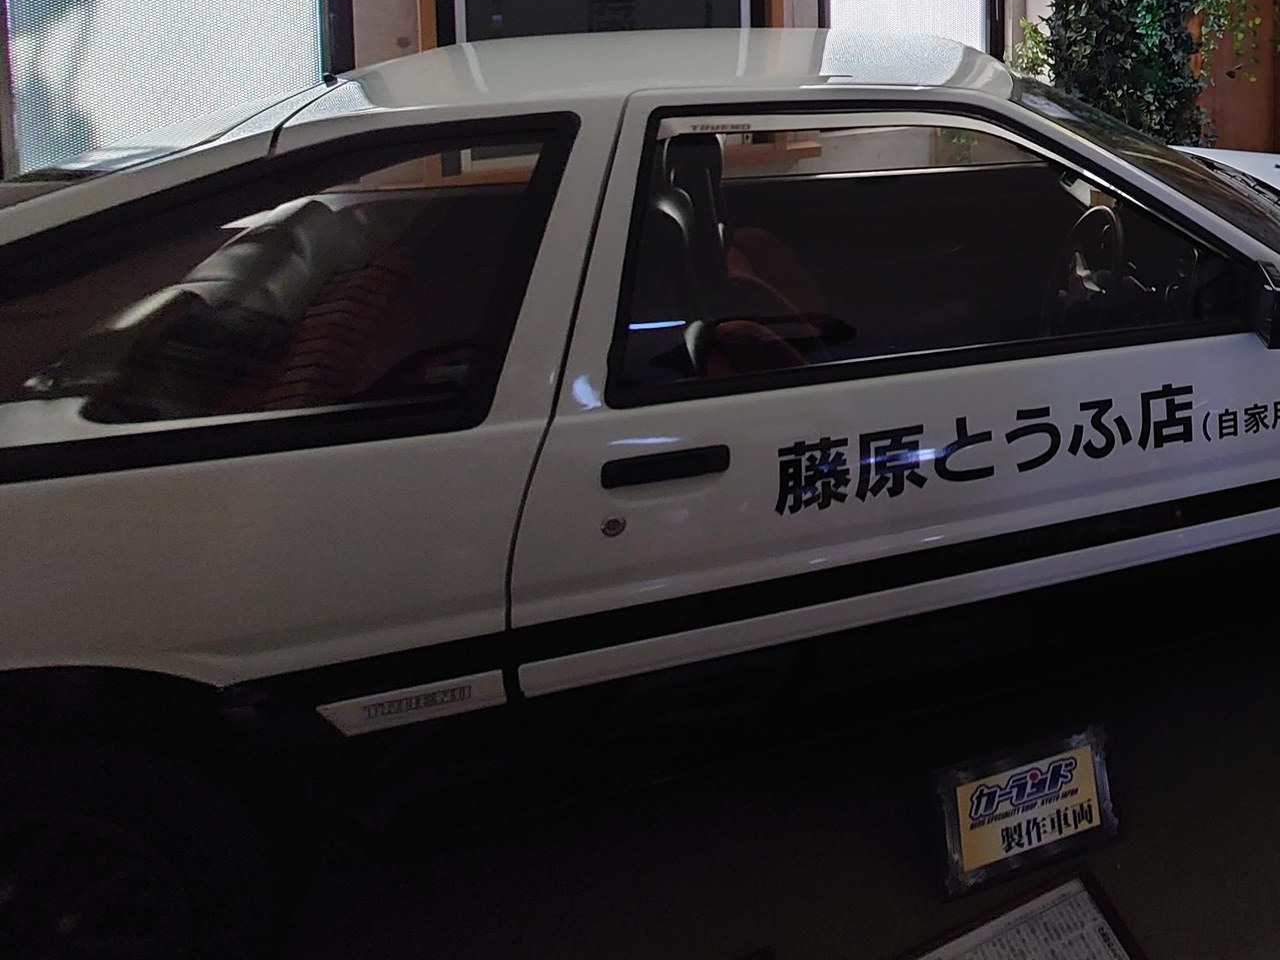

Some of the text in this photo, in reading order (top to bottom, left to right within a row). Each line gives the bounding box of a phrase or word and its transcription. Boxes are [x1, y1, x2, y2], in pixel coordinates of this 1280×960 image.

[775, 382, 1195, 516] 藤原とうふ店
[1001, 798, 1093, 853] 製作車両
